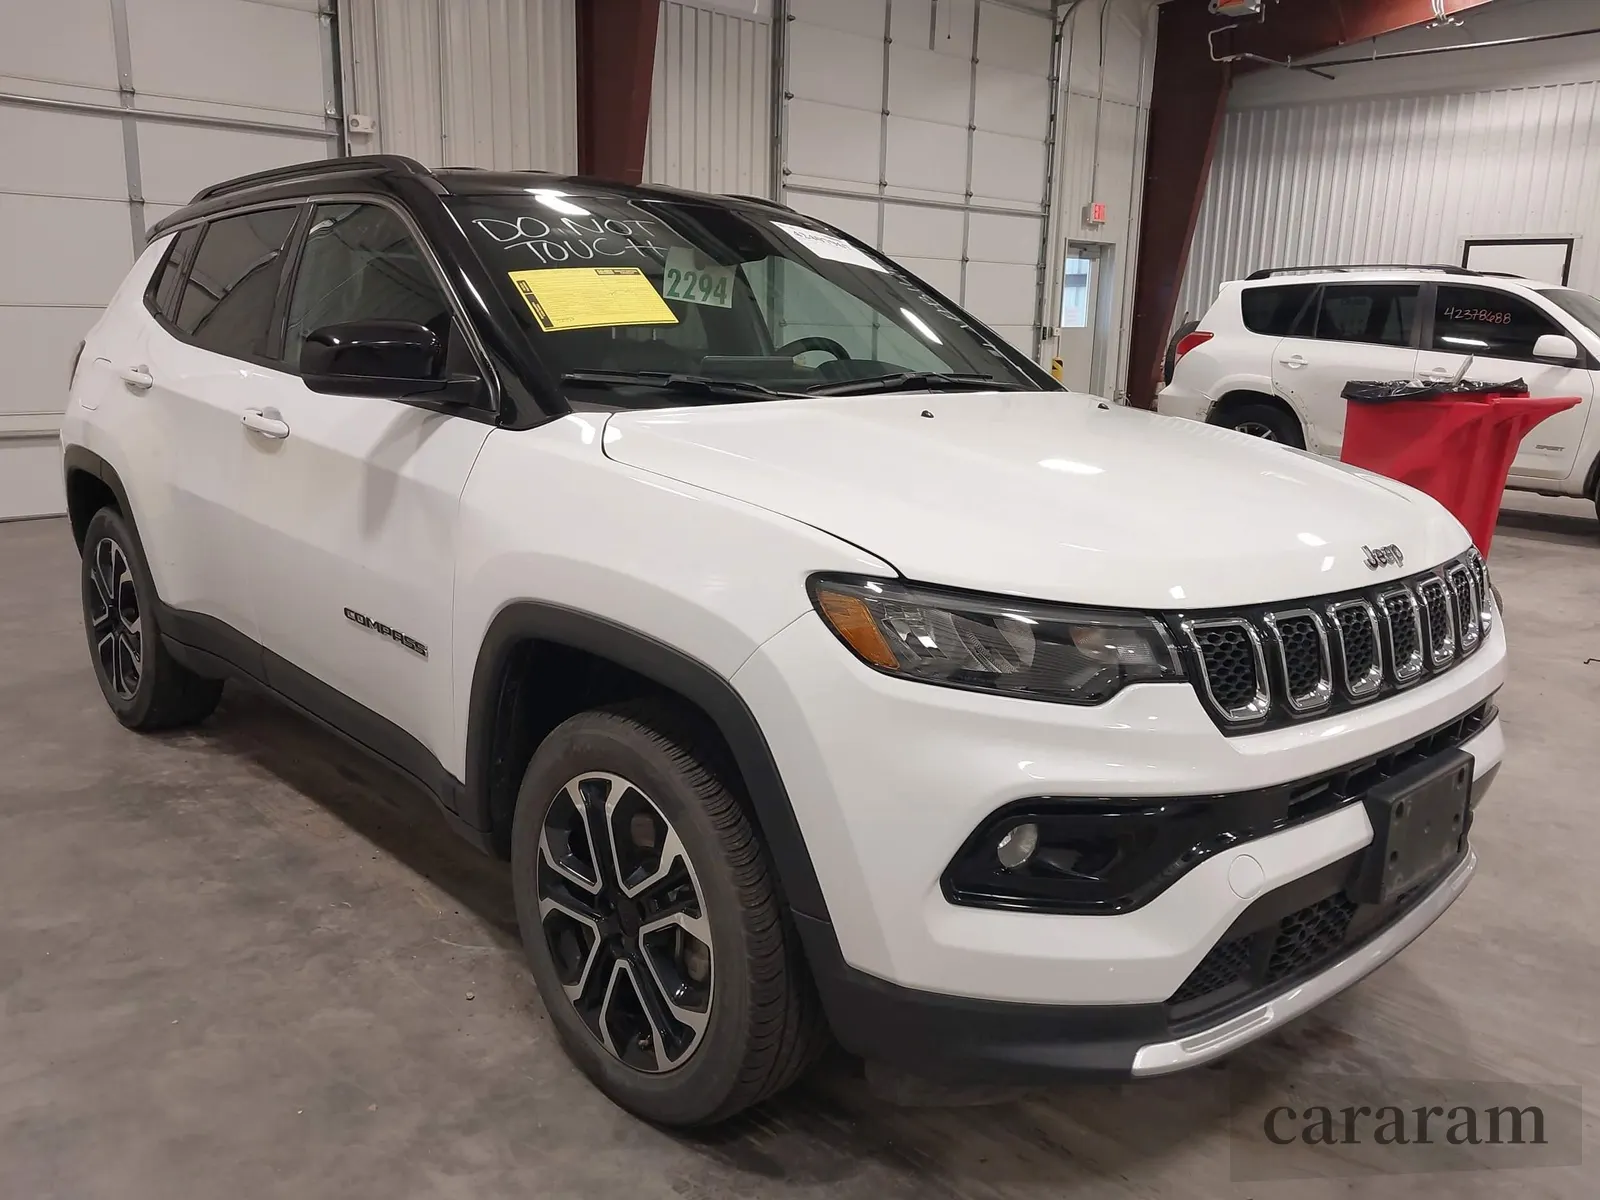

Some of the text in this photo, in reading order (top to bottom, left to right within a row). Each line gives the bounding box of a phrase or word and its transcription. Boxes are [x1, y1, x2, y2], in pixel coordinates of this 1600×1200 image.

[472, 217, 656, 241] DO NOT
[504, 237, 668, 263] TOUCH
[667, 268, 728, 305] 2294
[1360, 544, 1404, 571] Jeep
[343, 607, 428, 657] COMPASS
